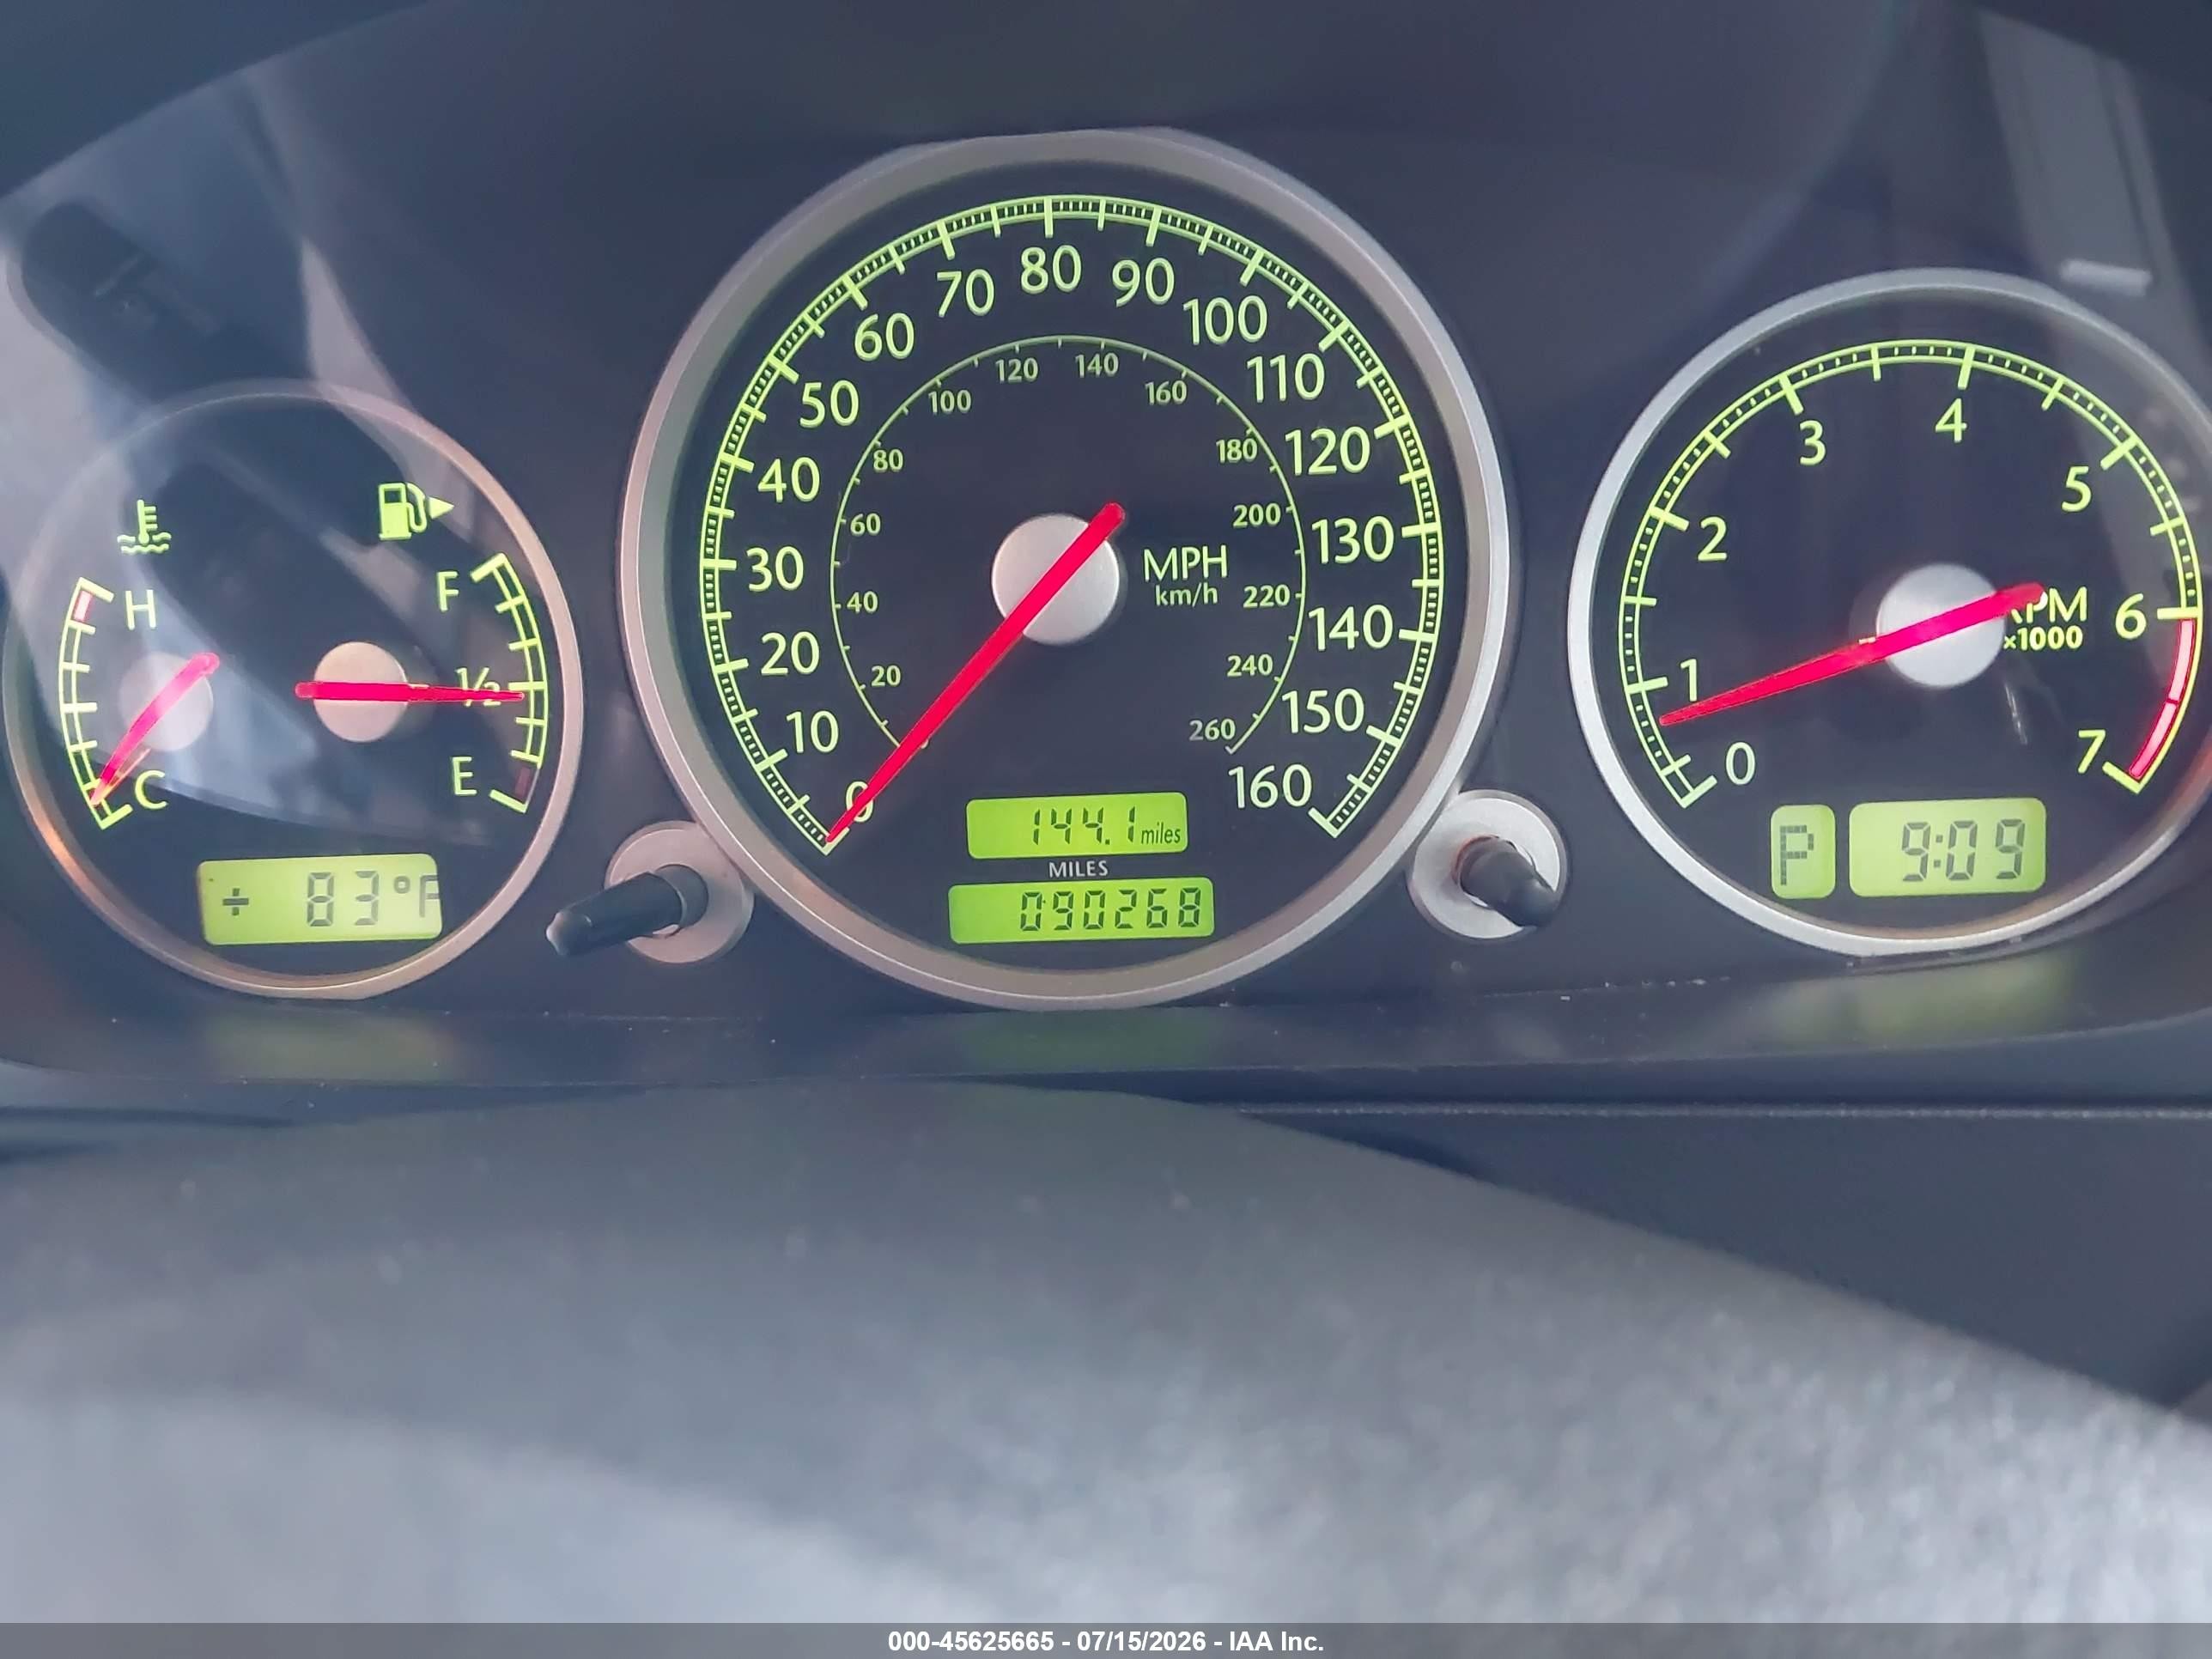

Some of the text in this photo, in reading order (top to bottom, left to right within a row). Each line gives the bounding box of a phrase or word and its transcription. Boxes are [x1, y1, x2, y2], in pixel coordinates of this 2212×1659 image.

[1021, 246, 1081, 293] 80
[1113, 258, 1175, 307] 90
[936, 270, 994, 317] 70
[854, 313, 915, 361] 60
[1183, 295, 1267, 345] 100
[996, 357, 1038, 382] 120
[1075, 352, 1119, 377] 140
[1247, 353, 1325, 403] 110
[799, 380, 860, 428] 50
[928, 389, 971, 413] 100
[1145, 380, 1188, 404] 160
[1936, 398, 1966, 442] 4
[873, 449, 903, 472] 80
[1216, 438, 1258, 462] 180
[1285, 426, 1370, 476] 120
[1800, 421, 1826, 465] 3
[757, 457, 820, 502] 40
[2061, 466, 2092, 512] 5
[850, 513, 881, 536] 60
[1232, 503, 1281, 527] 200
[1311, 515, 1395, 564] 130
[1698, 517, 1727, 562] 2
[746, 546, 804, 592] 30
[1144, 544, 1228, 581] MPH
[125, 589, 156, 630] H
[437, 571, 459, 611] F
[847, 591, 878, 613] 40
[1155, 583, 1218, 607] km/h
[1243, 584, 1291, 608] 220
[2009, 586, 2087, 623] PM
[1308, 604, 1394, 651] 140
[2115, 593, 2147, 640] 6
[761, 631, 820, 675] 20
[1227, 653, 1273, 677] 240
[871, 665, 902, 687] 20
[1680, 659, 1698, 702] 1
[786, 710, 839, 753] 10
[1188, 718, 1236, 741] 260
[1281, 688, 1364, 733] 150
[1726, 742, 1755, 785] 0
[2078, 730, 2106, 773] 7
[134, 769, 167, 810] C
[452, 756, 477, 795] E
[1228, 763, 1313, 809] 160
[846, 781, 874, 823] 0
[1032, 805, 1182, 846] 144.1 miles
[1048, 860, 1109, 878] MILES
[1780, 824, 1814, 885] P
[1902, 818, 2026, 881] 9:09
[1020, 887, 1200, 932] 090268
